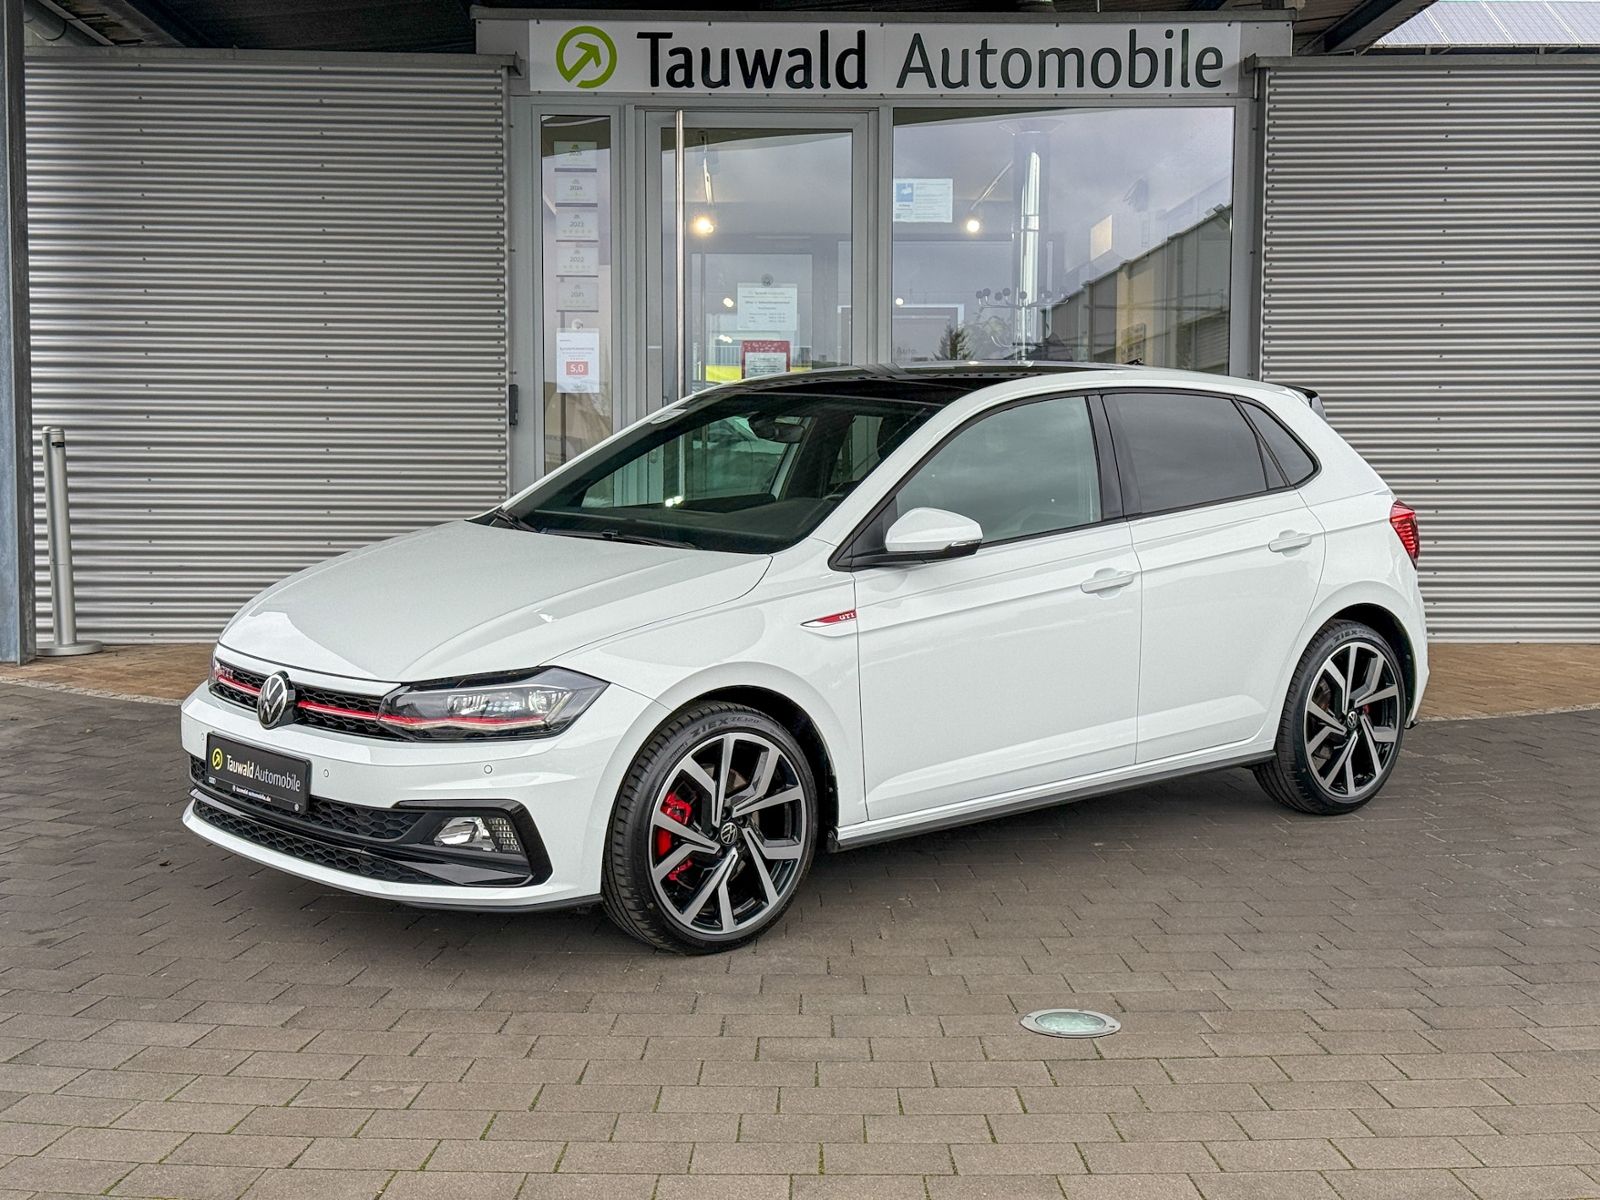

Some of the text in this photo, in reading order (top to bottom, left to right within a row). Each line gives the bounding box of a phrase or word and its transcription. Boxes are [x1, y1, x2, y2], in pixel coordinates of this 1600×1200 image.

[636, 28, 1225, 90] Tauwald Automobile
[839, 612, 855, 620] GTI
[690, 719, 729, 737] ZIEX
[226, 754, 301, 792] Tauwald Automobile
